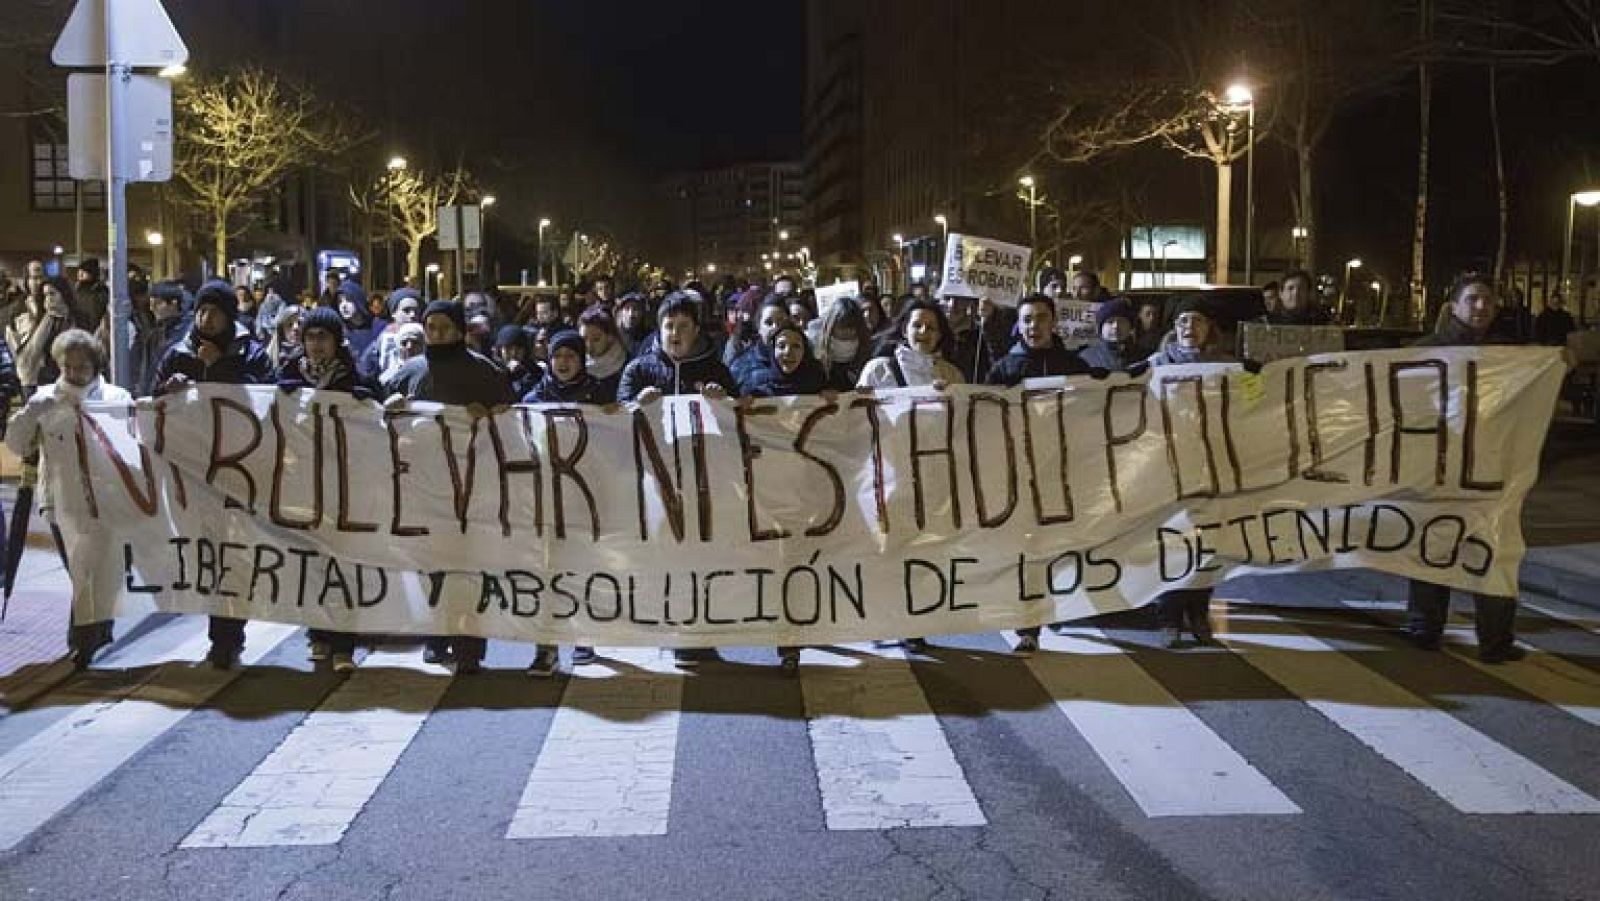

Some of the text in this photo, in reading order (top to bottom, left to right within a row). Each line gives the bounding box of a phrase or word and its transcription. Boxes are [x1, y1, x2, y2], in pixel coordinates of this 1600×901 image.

[206, 397, 600, 541] BULEVAR
[632, 399, 712, 543] NI
[735, 389, 1075, 542] ESTADO
[1103, 358, 1505, 513] POLICIAL
[123, 537, 388, 609] LIBERTAD
[477, 549, 866, 627] ABSOLUCIÓN
[904, 557, 980, 615] DE
[1018, 550, 1122, 601] LOS
[1156, 504, 1493, 583] DETENIDOS
